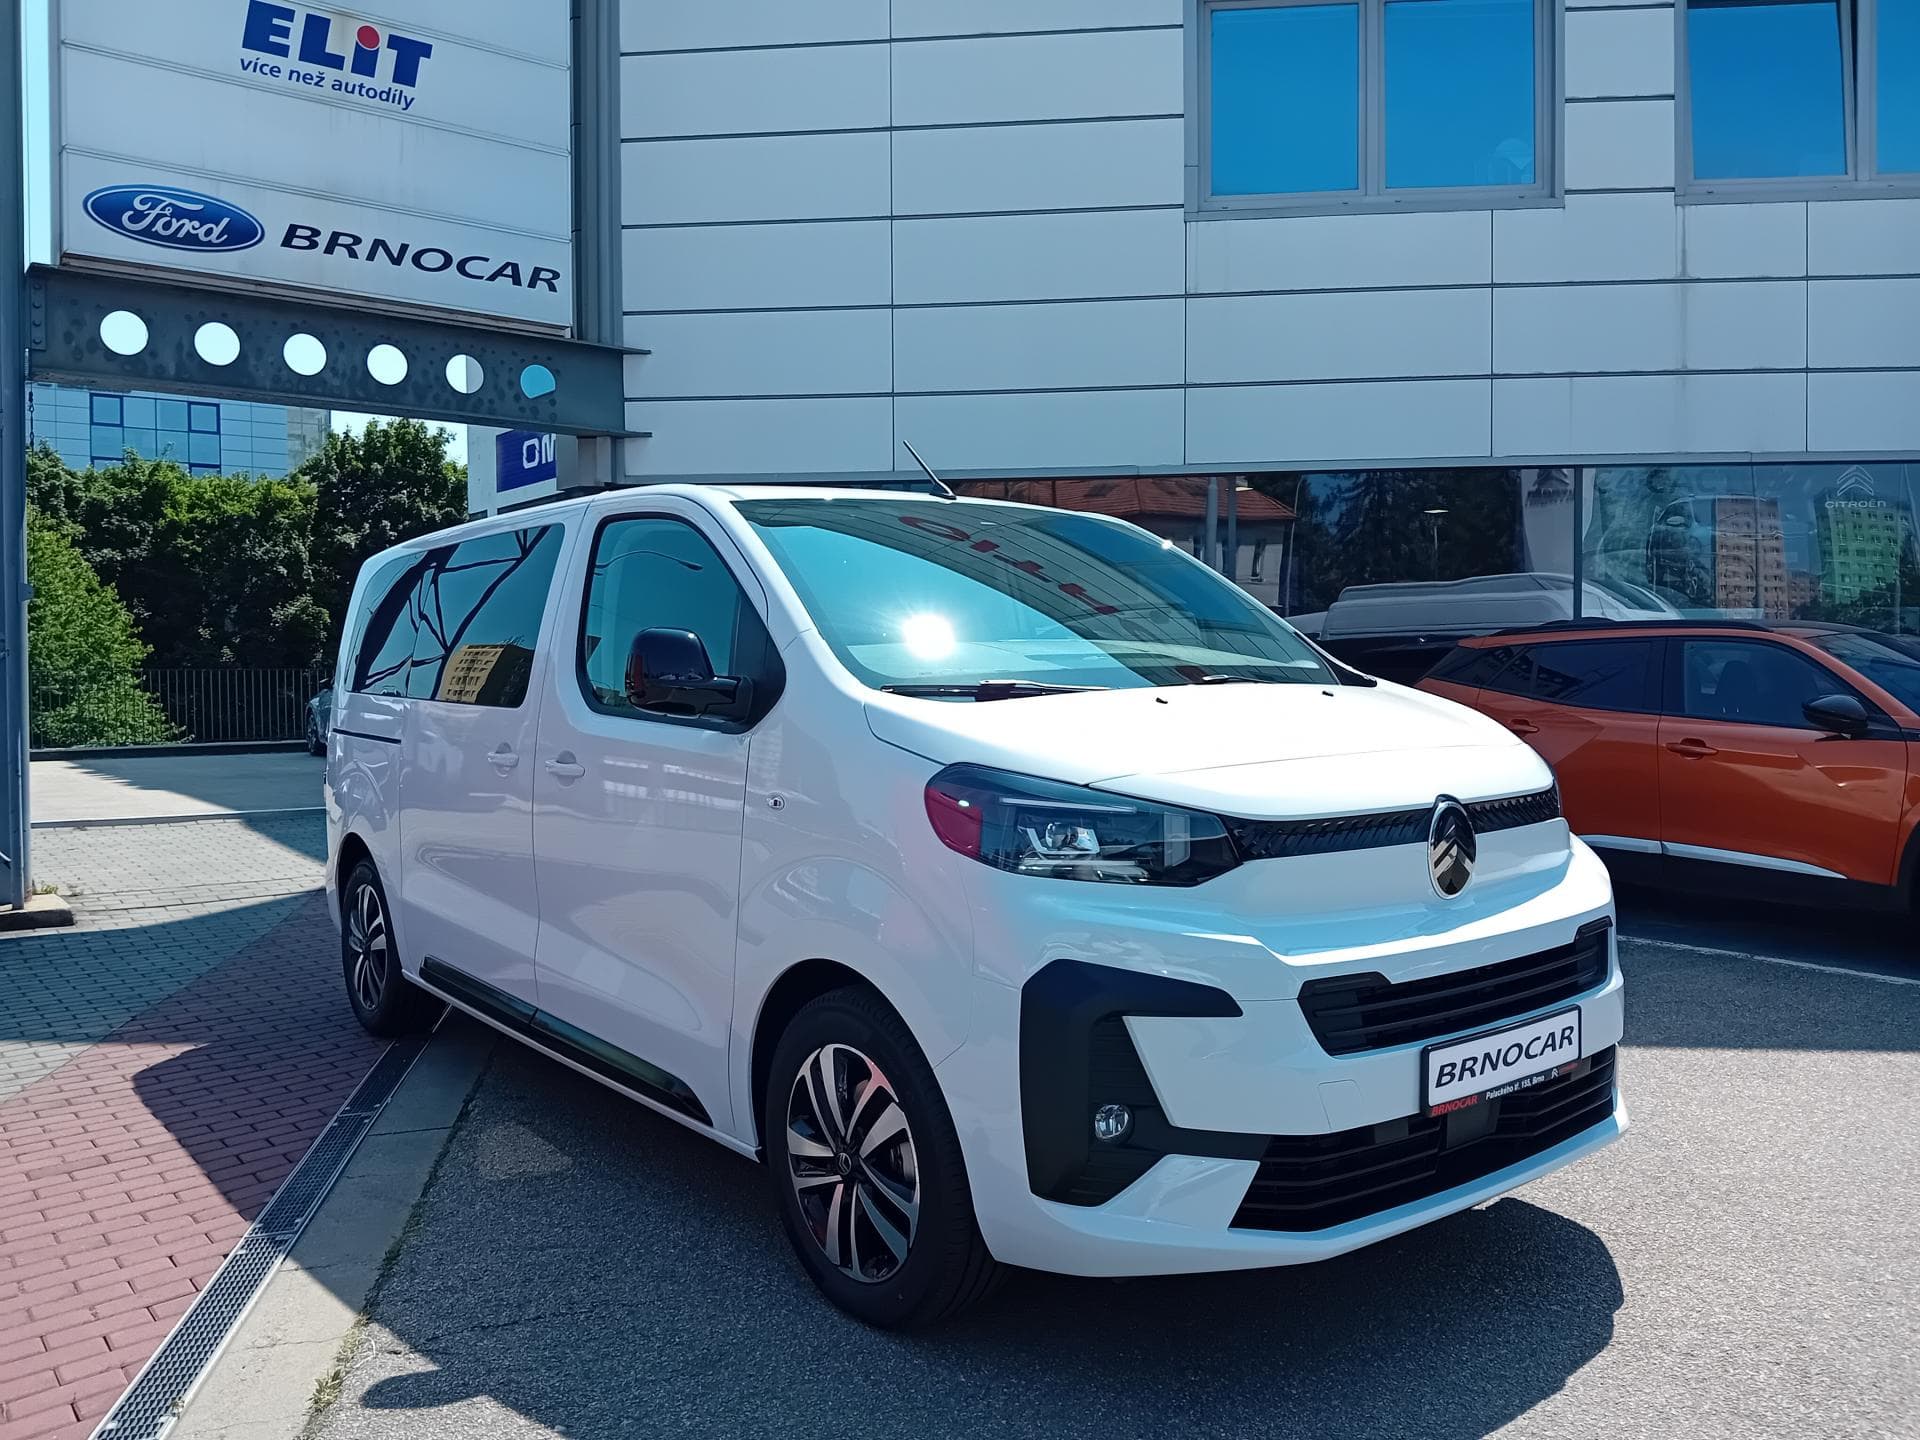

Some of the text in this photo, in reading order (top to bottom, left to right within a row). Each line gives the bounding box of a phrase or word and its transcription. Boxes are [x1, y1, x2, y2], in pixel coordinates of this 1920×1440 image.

[240, 57, 415, 111] více než autodíly
[121, 194, 229, 245] Ford
[280, 223, 561, 292] BRNOCAR
[1435, 1025, 1575, 1089] BRNOCAR
[1432, 1095, 1478, 1116] BRNOCAR
